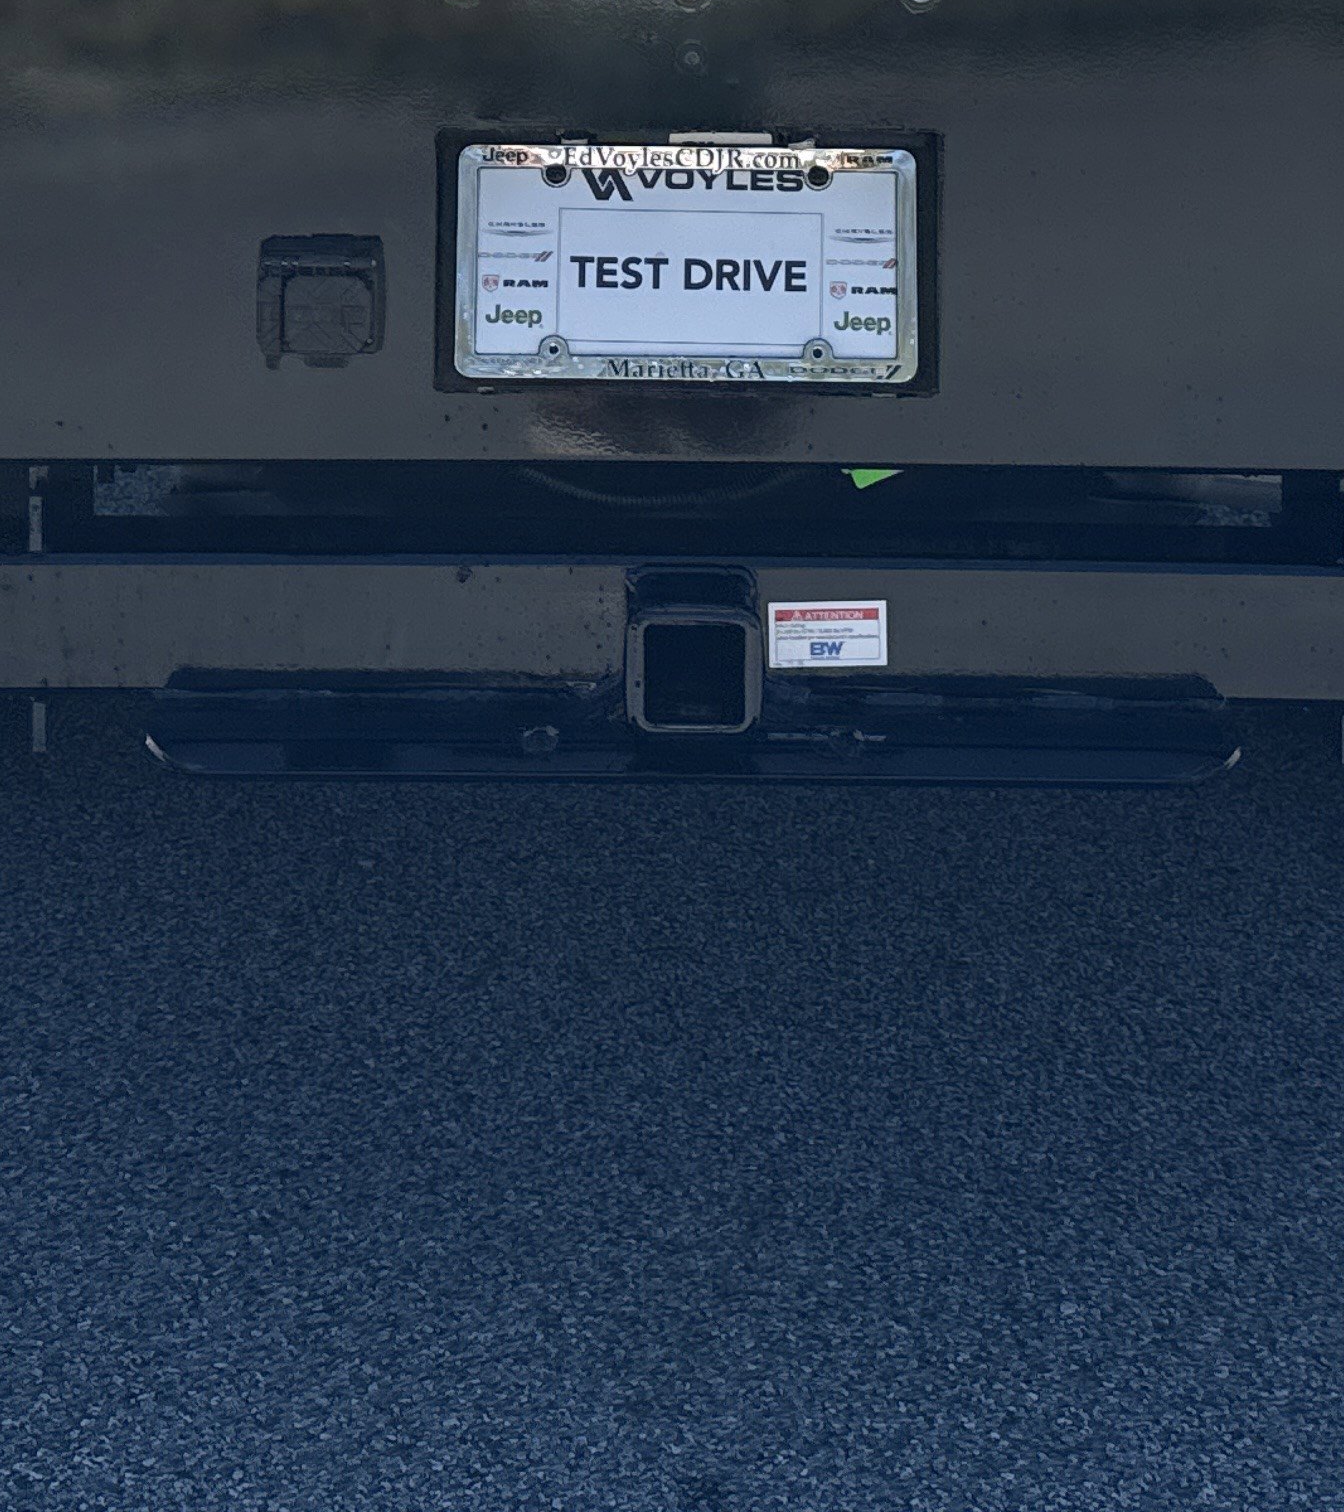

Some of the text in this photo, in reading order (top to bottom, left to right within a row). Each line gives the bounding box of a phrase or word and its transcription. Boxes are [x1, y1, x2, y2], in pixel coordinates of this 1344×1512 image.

[483, 147, 529, 165] Jeep
[564, 146, 801, 173] EdVoylesCDJR.com
[846, 155, 893, 165] RAM
[636, 168, 805, 192] VOYLES
[502, 279, 549, 288] RAM
[569, 255, 808, 293] TEST DRIVE
[850, 286, 898, 295] RAM
[485, 304, 543, 328] Jeep
[833, 311, 892, 335] Jeep
[724, 360, 766, 379] GA
[804, 610, 865, 621] ATTENTION
